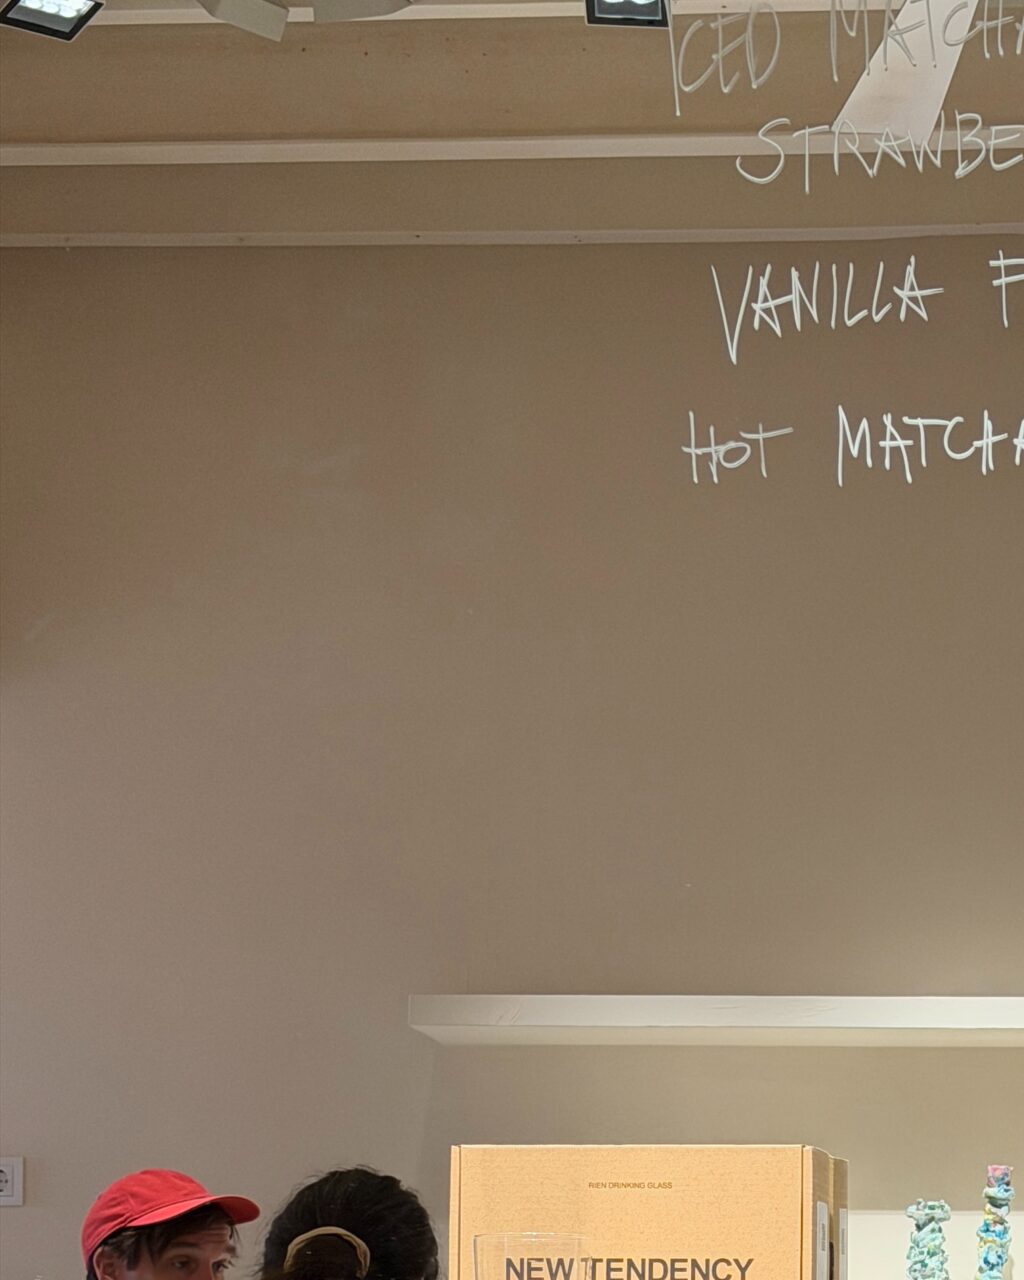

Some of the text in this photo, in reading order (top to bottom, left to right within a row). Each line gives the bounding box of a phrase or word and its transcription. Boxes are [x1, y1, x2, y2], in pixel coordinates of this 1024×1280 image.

[710, 255, 945, 365] VANILLA
[681, 410, 794, 484] HOT
[647, 1181, 673, 1189] GLASS
